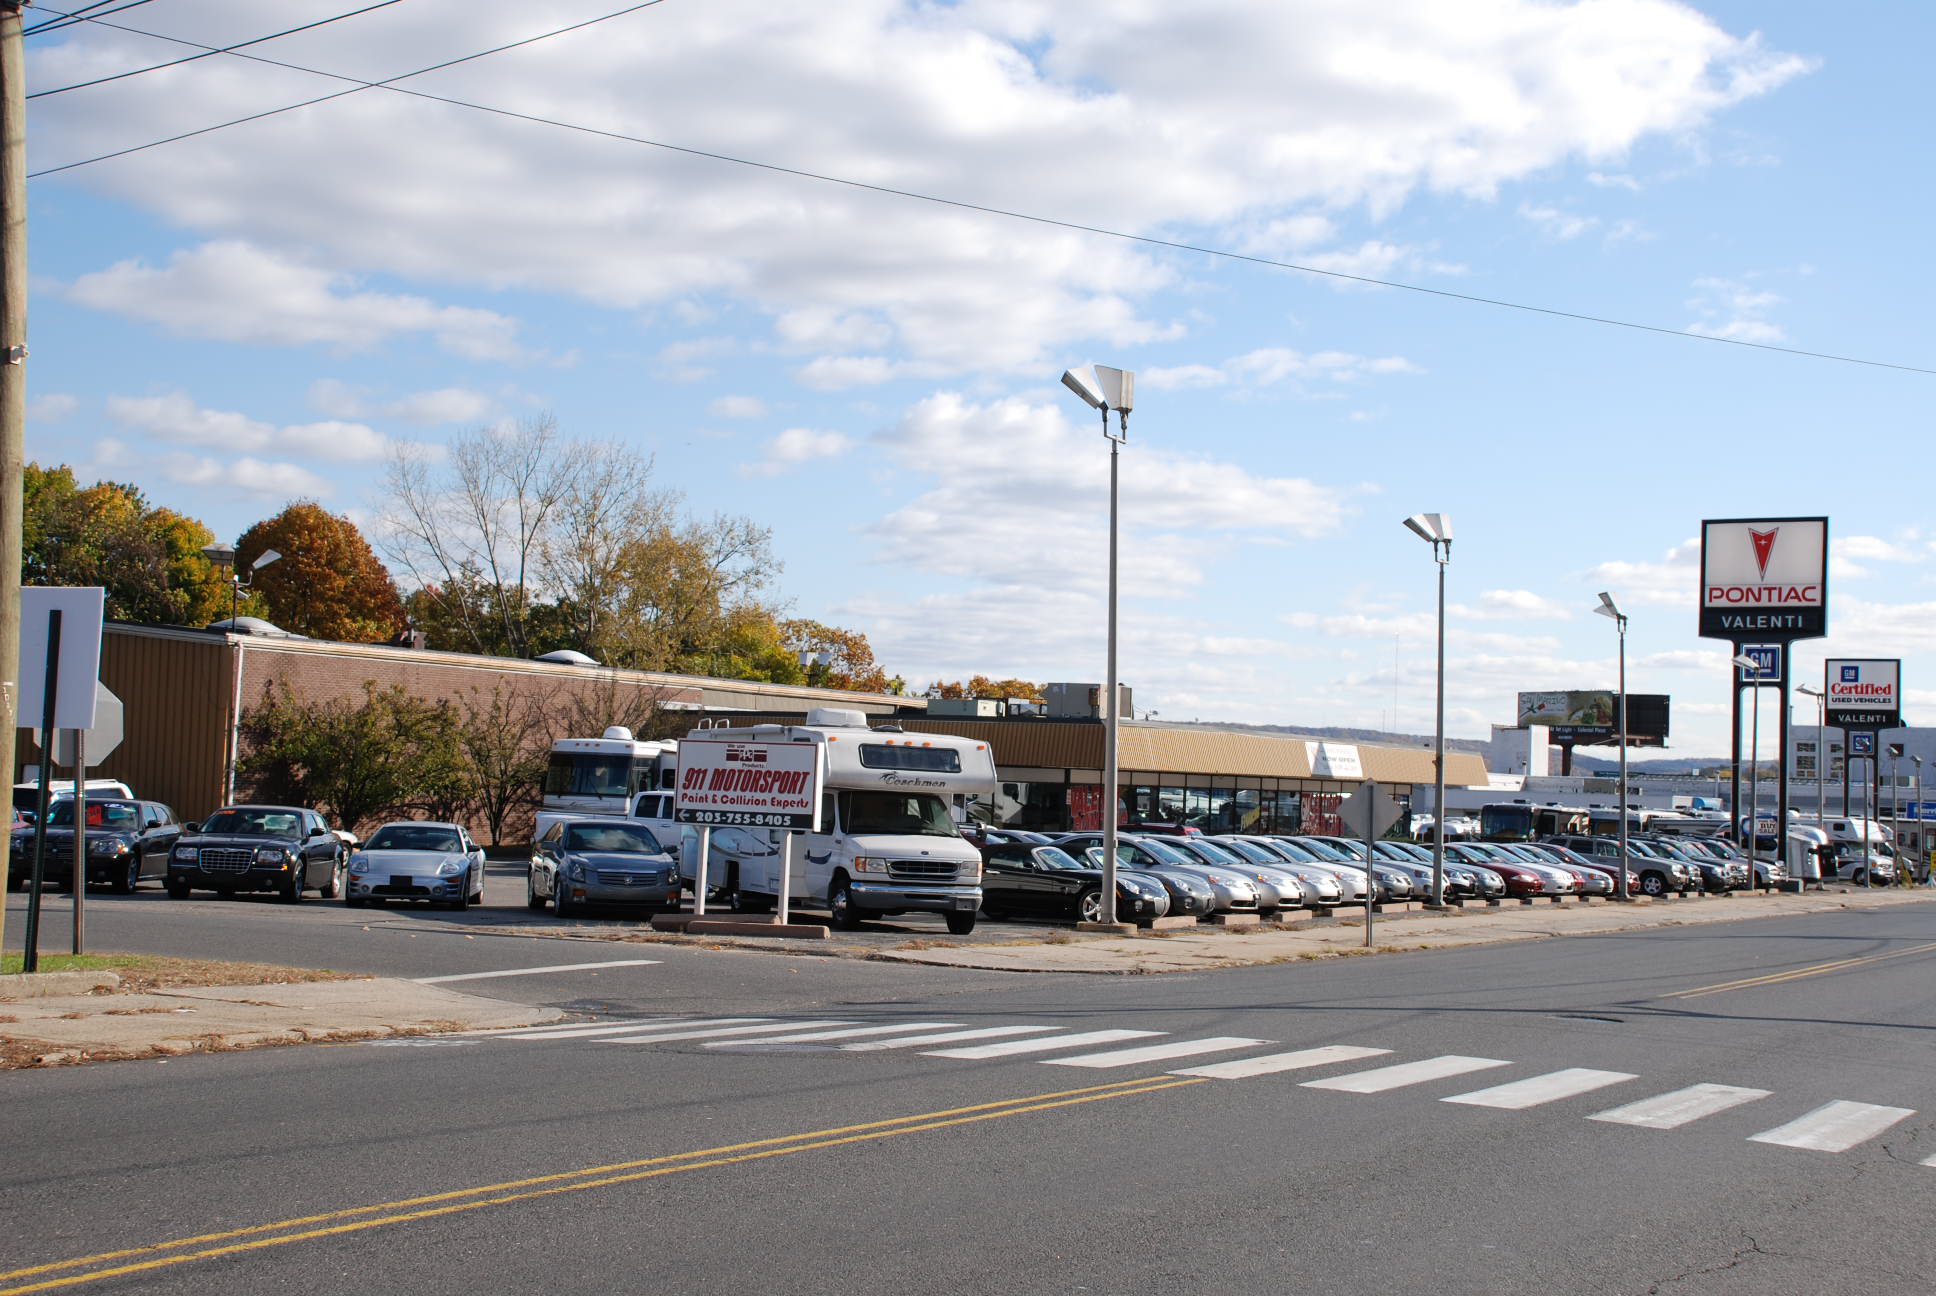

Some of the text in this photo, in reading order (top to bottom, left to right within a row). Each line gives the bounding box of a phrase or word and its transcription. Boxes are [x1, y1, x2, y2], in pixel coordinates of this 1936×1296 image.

[1708, 586, 1817, 603] PONTIAC
[1721, 615, 1803, 629] VALENTI
[1750, 652, 1772, 668] GM
[1844, 669, 1856, 677] GM
[1831, 682, 1892, 695] Certified
[1838, 714, 1886, 723] VALENTI
[682, 767, 811, 795] 911 MOTORSPORT
[681, 792, 809, 810] Paint & Collision Experts
[695, 811, 792, 826] 203-755-8405
